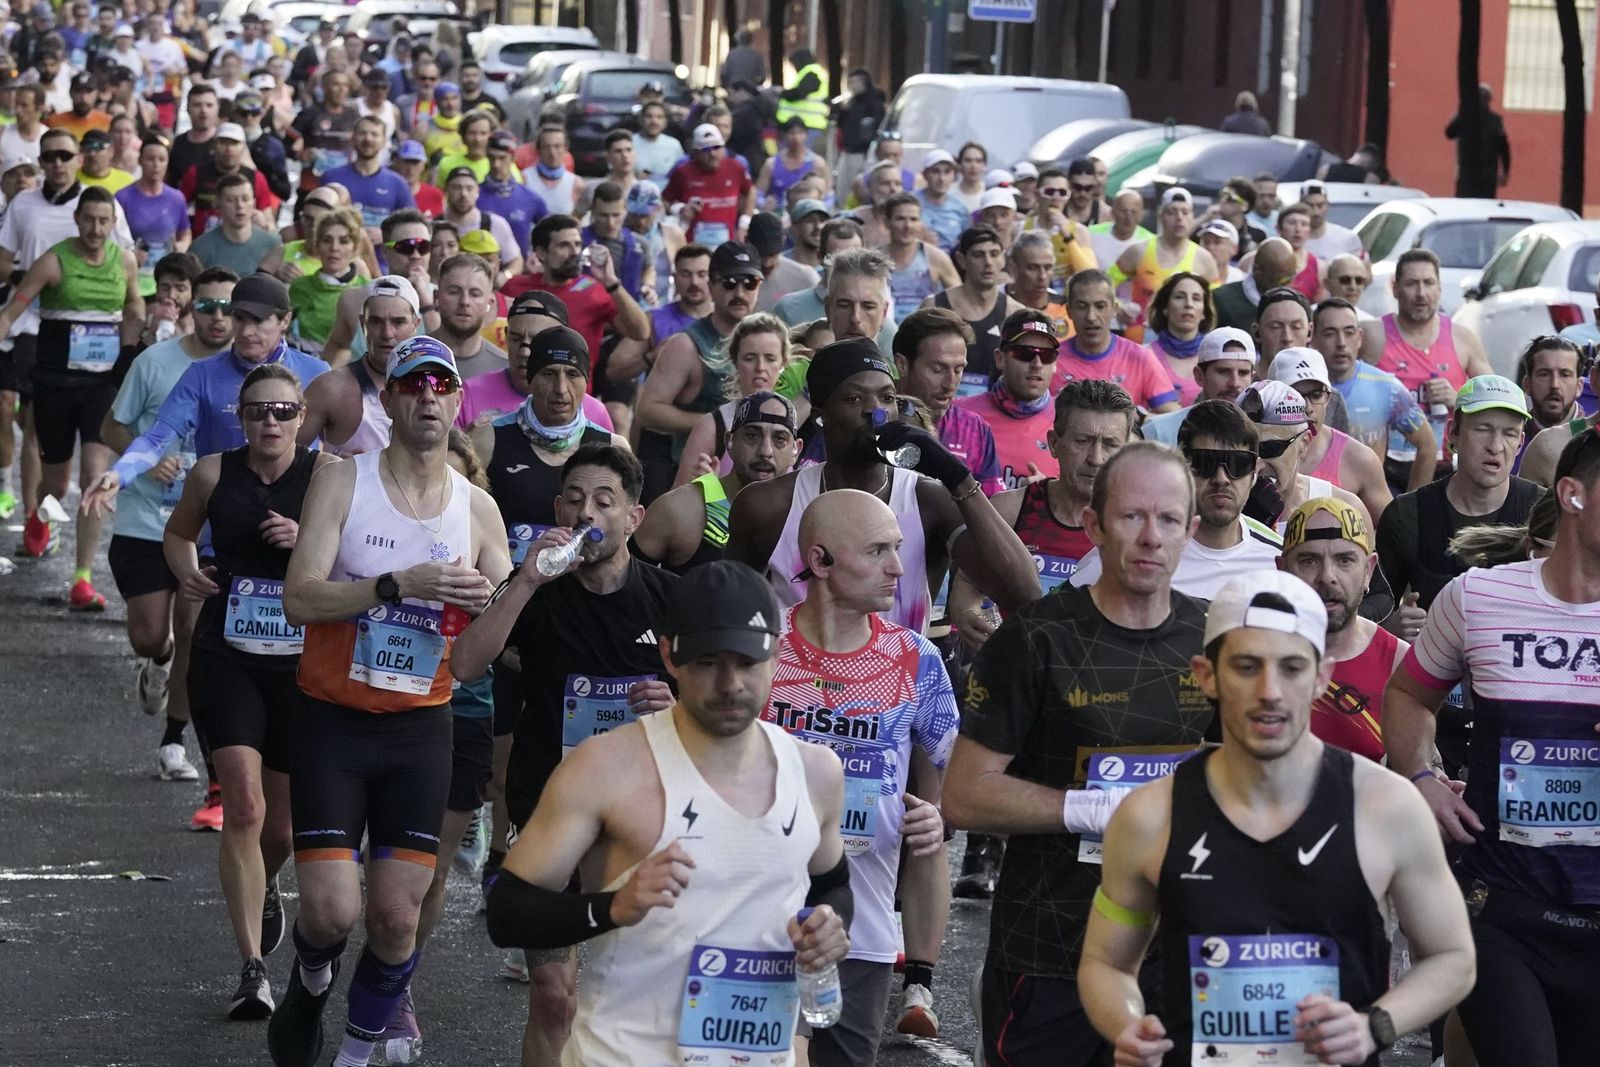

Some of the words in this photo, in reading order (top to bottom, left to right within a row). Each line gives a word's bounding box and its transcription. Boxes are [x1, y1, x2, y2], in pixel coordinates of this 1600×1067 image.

[365, 534, 395, 549] GOBIK
[1050, 561, 1078, 575] ZUR
[258, 584, 284, 596] ZUR
[258, 606, 282, 617] 7185
[234, 618, 303, 638] CAMILLA
[391, 610, 437, 631] ZURICH
[387, 635, 412, 649] 6641
[375, 649, 414, 671] OLEA
[1502, 633, 1600, 672] TOA
[595, 682, 637, 696] ZURI
[1092, 691, 1129, 704] MONS
[596, 709, 625, 722] 5943
[772, 700, 881, 741] TriSani
[1543, 746, 1600, 761] ZURIC
[843, 757, 871, 773] ICH
[1132, 761, 1183, 777] ZURI
[1545, 779, 1582, 794] 8809
[1505, 799, 1600, 822] FRANCO
[1239, 941, 1321, 961] ZURICH
[733, 958, 795, 976] ZURICH
[1243, 983, 1286, 1002] 6842
[730, 994, 768, 1013] 7647
[701, 1016, 782, 1046] GUIRAO
[1201, 1010, 1291, 1037] GUILLE
